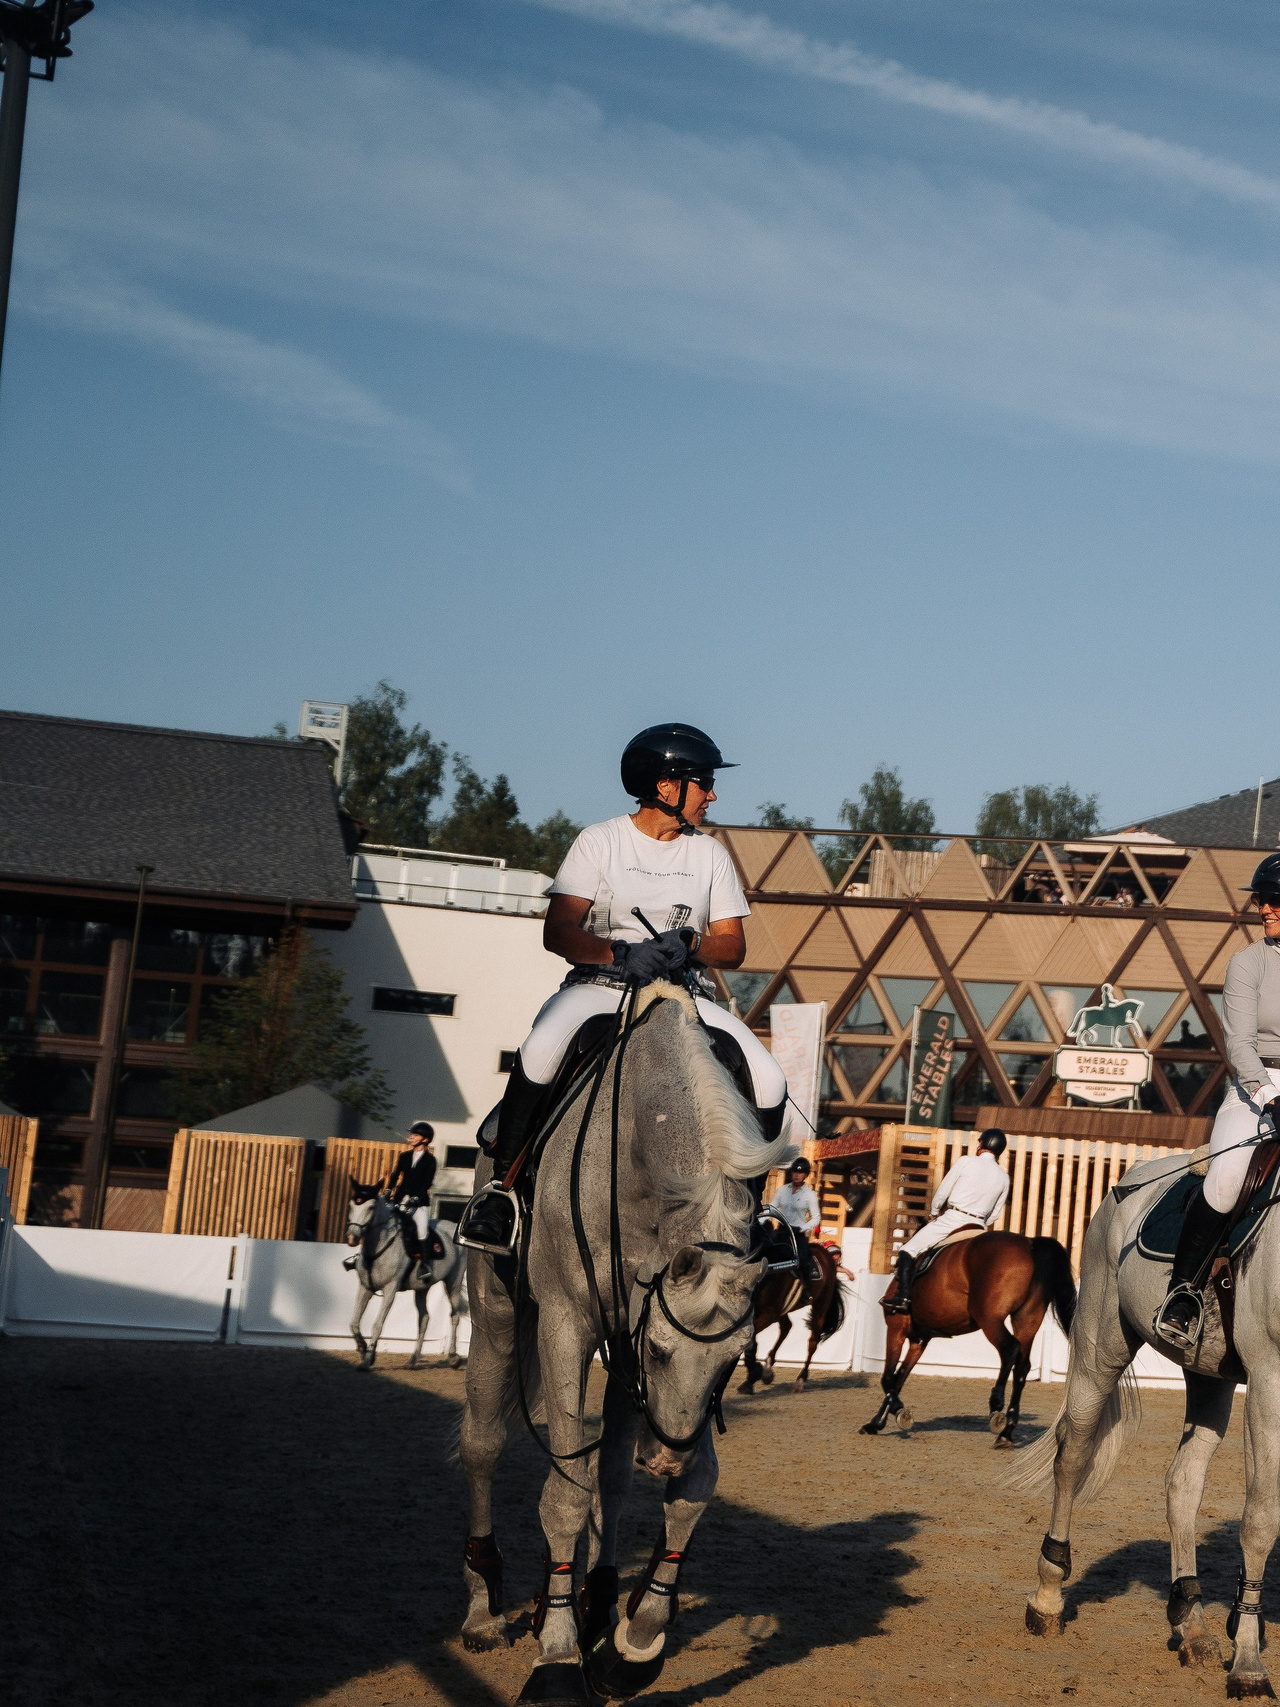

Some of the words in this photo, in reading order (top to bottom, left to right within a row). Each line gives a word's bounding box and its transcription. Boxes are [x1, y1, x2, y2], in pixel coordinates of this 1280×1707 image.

[911, 1015, 950, 1104] EMERALD
[918, 1038, 955, 1119] STABLES
[1076, 1055, 1129, 1066] EMERALD
[1078, 1066, 1125, 1076] STABLES
